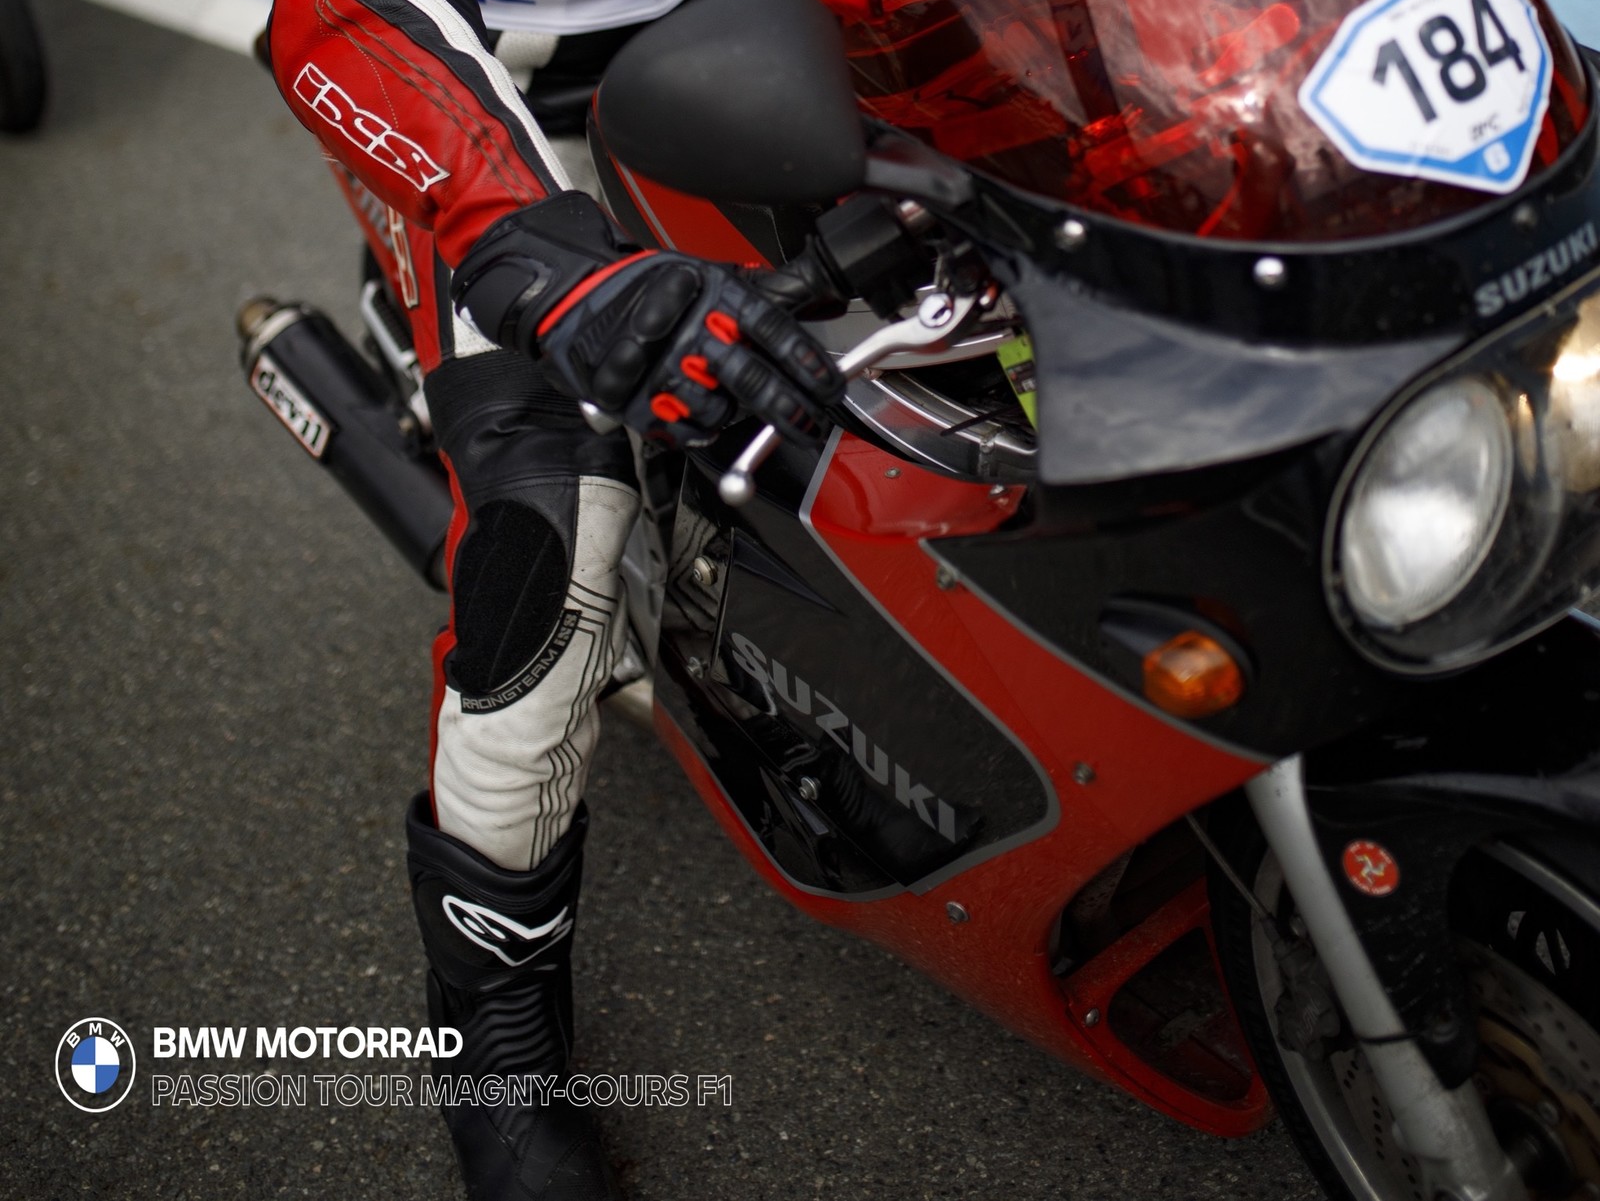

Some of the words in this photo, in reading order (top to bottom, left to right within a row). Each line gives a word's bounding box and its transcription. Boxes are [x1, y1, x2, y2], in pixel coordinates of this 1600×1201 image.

[1474, 221, 1598, 317] SUZUKI
[259, 371, 322, 450] devil
[731, 632, 956, 844] SUZUKI
